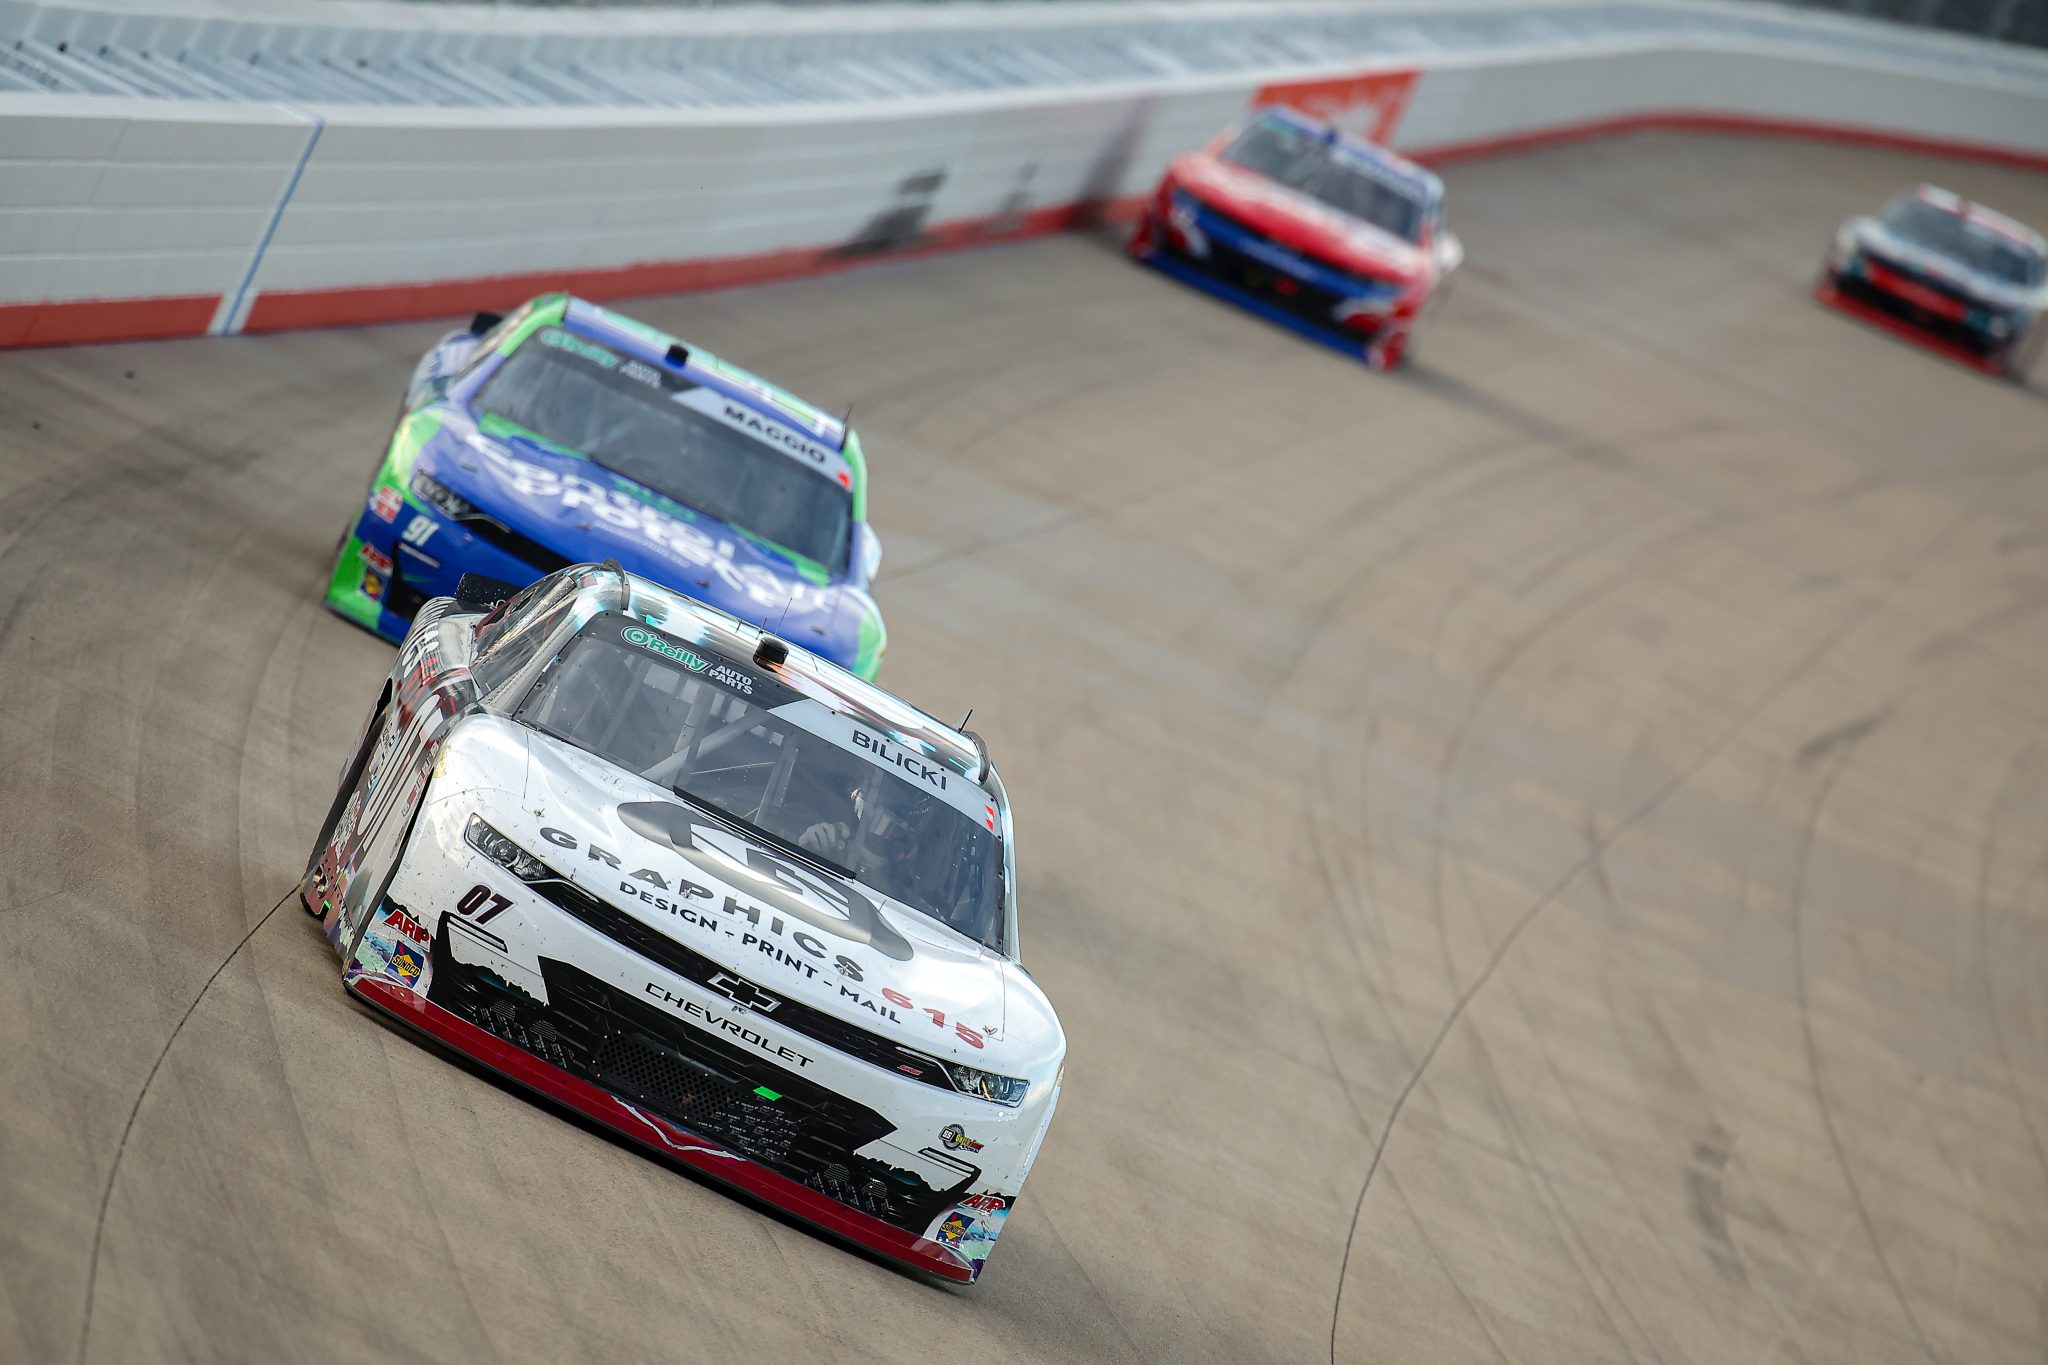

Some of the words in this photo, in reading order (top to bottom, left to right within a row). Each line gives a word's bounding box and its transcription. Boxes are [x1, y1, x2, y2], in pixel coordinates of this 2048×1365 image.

[401, 514, 440, 547] 91
[623, 627, 711, 672] O'Reilly
[708, 669, 753, 695] PARTS
[716, 665, 753, 686] AUTO
[852, 729, 947, 790] BILICKI
[456, 884, 514, 925] 07
[384, 909, 430, 944] ARP
[540, 827, 864, 982] GRAPHICS
[881, 988, 984, 1049] 615
[391, 953, 421, 978] SUNOCO
[619, 881, 718, 932] DESIGN
[742, 932, 818, 979] PRINT
[839, 985, 901, 1024] MAIL
[645, 982, 814, 1068] CHEVROLET
